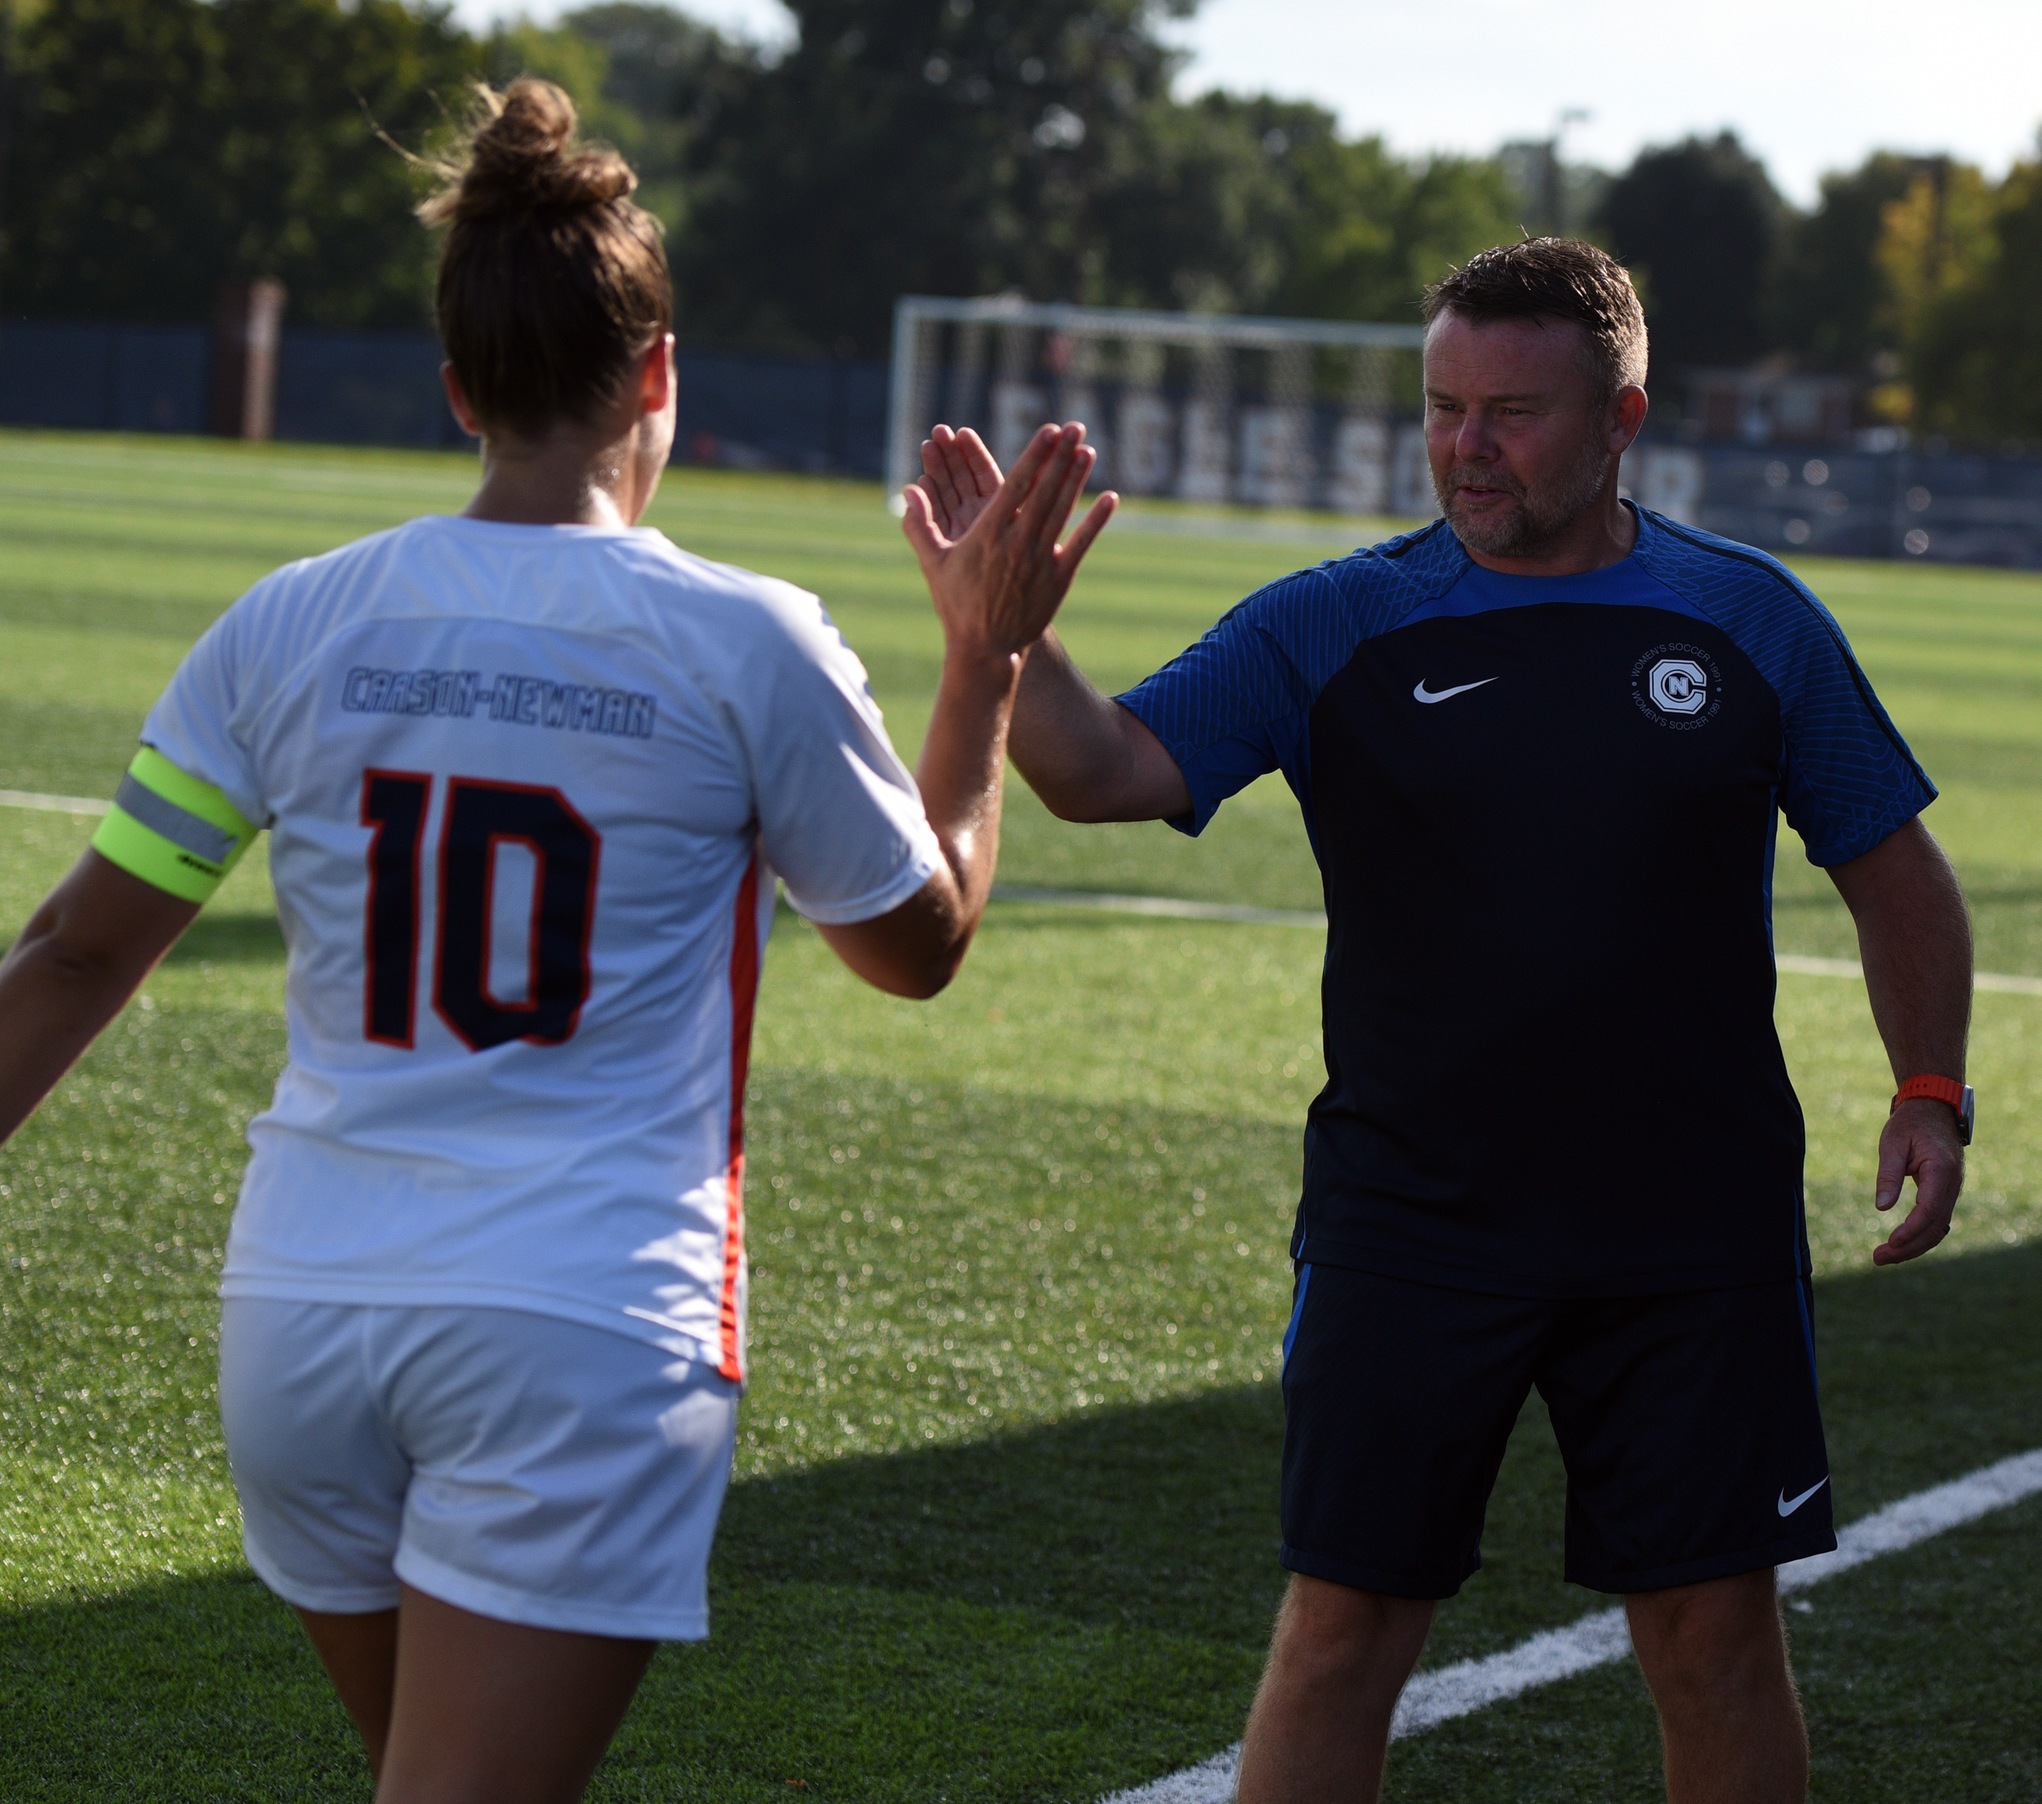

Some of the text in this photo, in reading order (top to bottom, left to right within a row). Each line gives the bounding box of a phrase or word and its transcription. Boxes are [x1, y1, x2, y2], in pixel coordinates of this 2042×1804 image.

[1631, 644, 1667, 677] WOMEN'S
[1668, 642, 1711, 662] SOCCER
[341, 666, 657, 739] CARSON-NEWMAN
[1632, 690, 1722, 731] WOMEN'S SOCCER 1991
[360, 767, 602, 1053] 10
